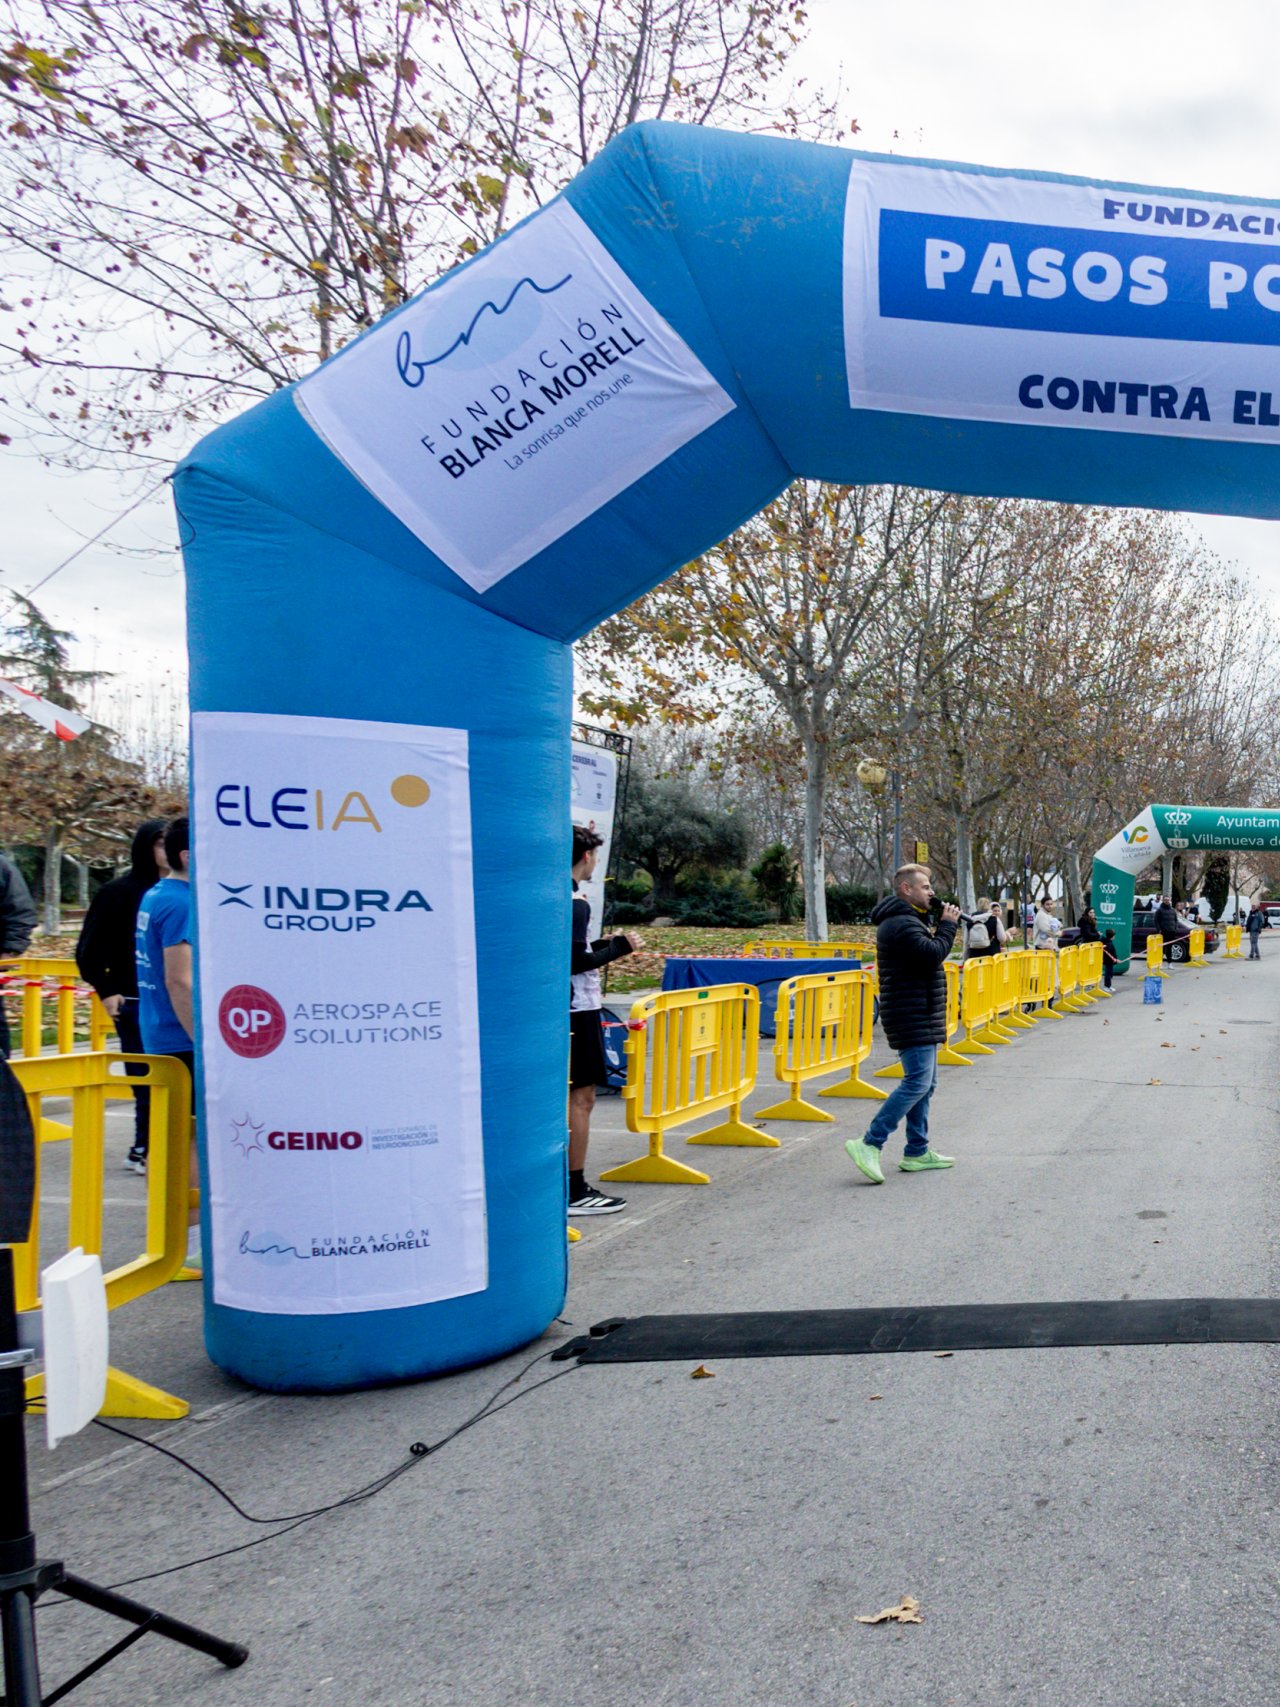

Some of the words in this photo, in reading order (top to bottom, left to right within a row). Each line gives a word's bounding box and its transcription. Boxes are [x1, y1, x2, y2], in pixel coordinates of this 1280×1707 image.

[925, 239, 1168, 306] PASOS
[421, 304, 622, 453] FUNDACIÓN
[439, 401, 545, 479] BLANCA
[540, 327, 645, 407] MORELL
[1018, 375, 1210, 421] CONTRA
[1233, 390, 1280, 426] EL
[504, 452, 524, 470] La
[522, 422, 566, 460] sonrisa
[564, 402, 588, 429] que
[586, 390, 610, 412] nos
[609, 372, 634, 394] une
[216, 784, 382, 833] ELEIA
[1192, 833, 1267, 847] Villanueva
[264, 886, 433, 912] INDRA
[264, 914, 376, 932] GROUP
[228, 1007, 272, 1038] QP
[293, 1001, 442, 1020] AEROSPACE
[294, 1025, 442, 1044] SOLUTIONS
[268, 1131, 363, 1150] GEINO
[312, 1229, 429, 1246] FUNDACIÓN
[312, 1245, 367, 1257] BLANCA
[373, 1238, 430, 1253] MORELL
